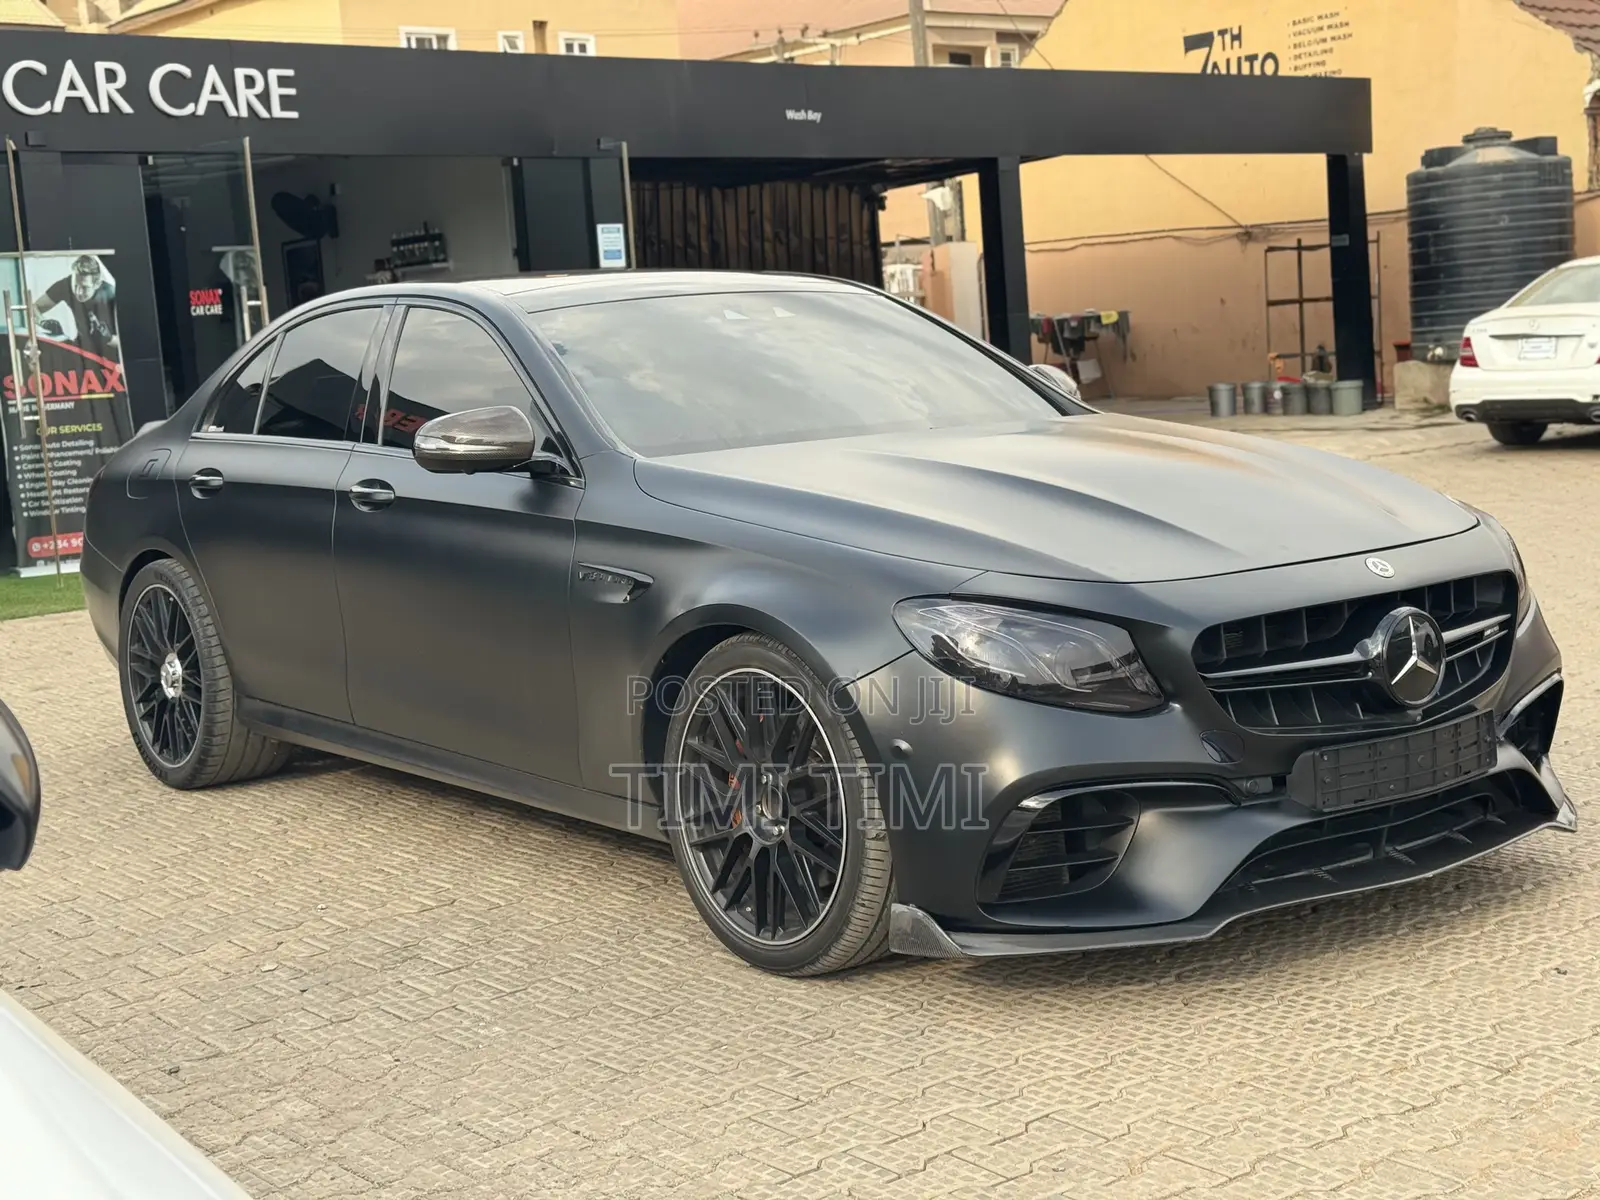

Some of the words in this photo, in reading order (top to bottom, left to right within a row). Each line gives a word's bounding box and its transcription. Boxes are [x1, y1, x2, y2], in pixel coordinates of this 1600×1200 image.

[2, 59, 134, 116] CAR
[148, 63, 299, 119] CARE
[785, 109, 807, 120] Wash
[807, 109, 822, 124] Bay
